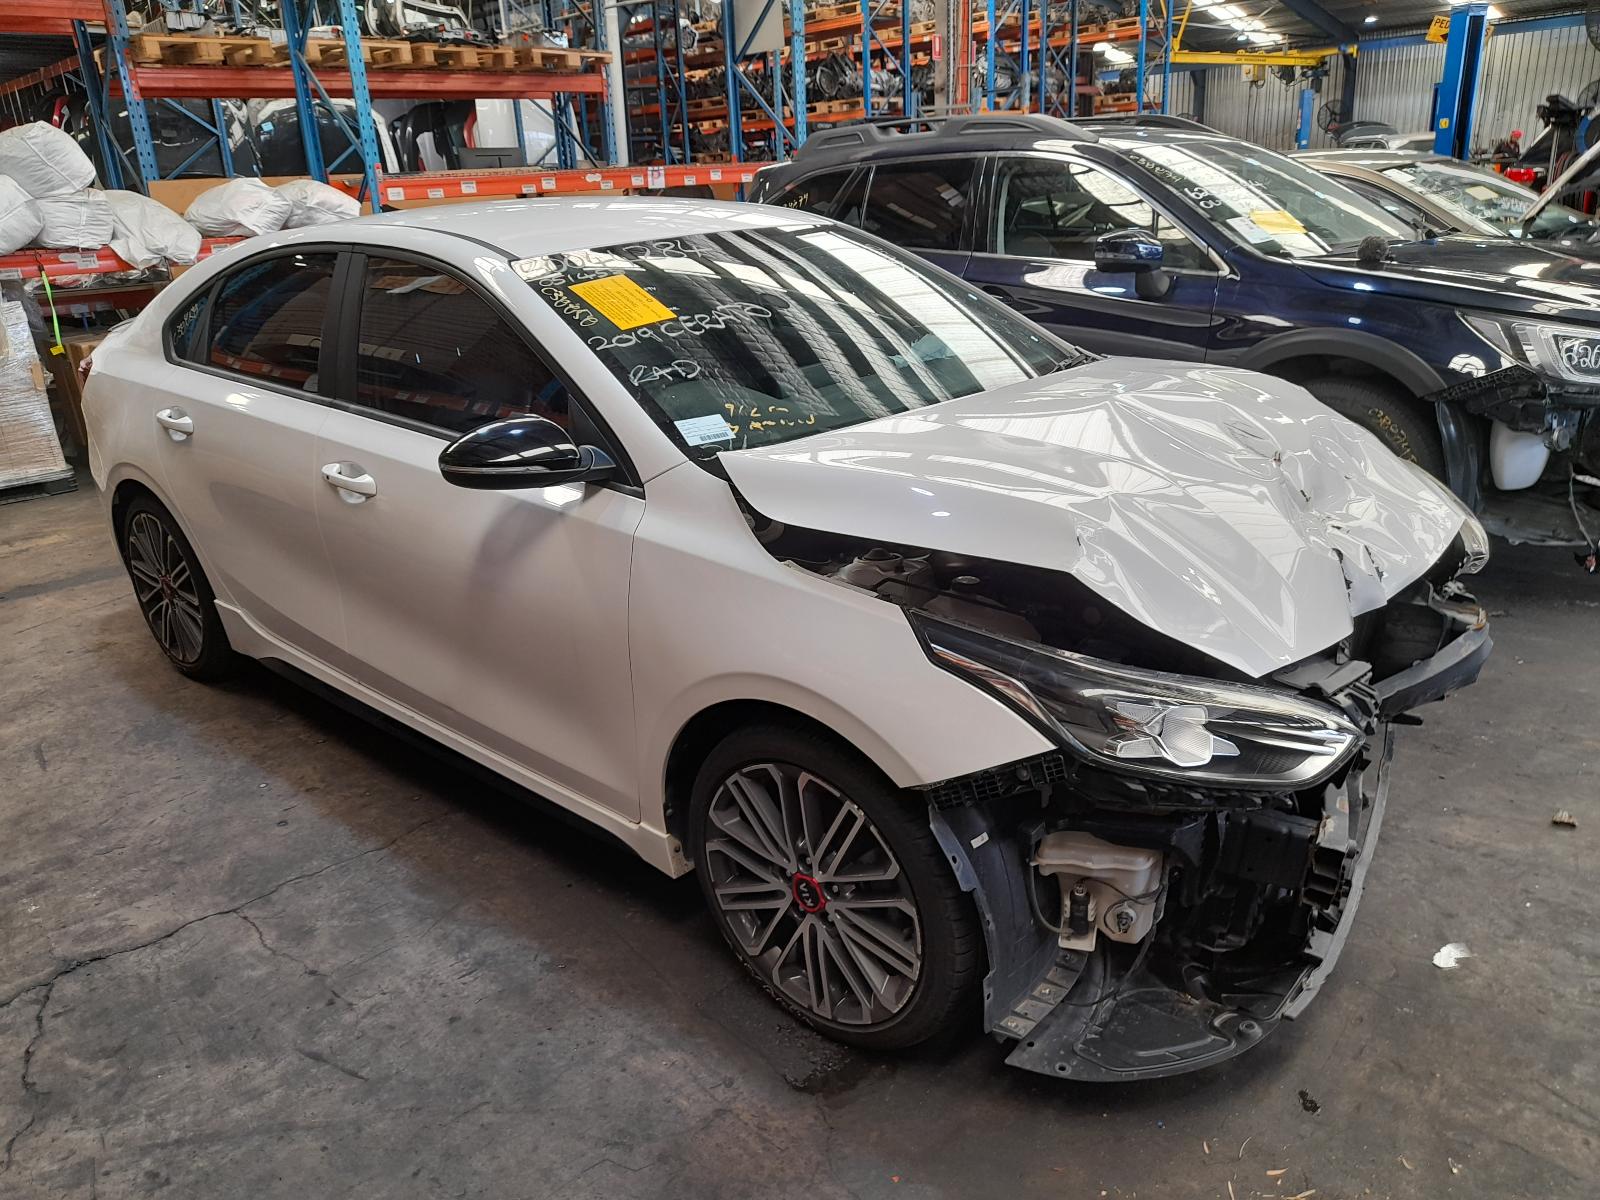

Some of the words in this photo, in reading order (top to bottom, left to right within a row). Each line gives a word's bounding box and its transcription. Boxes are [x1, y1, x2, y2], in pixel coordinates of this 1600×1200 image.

[588, 327, 664, 351] 2019
[660, 302, 772, 336] CERATO
[629, 359, 701, 387] RAD
[799, 882, 815, 907] KIA
